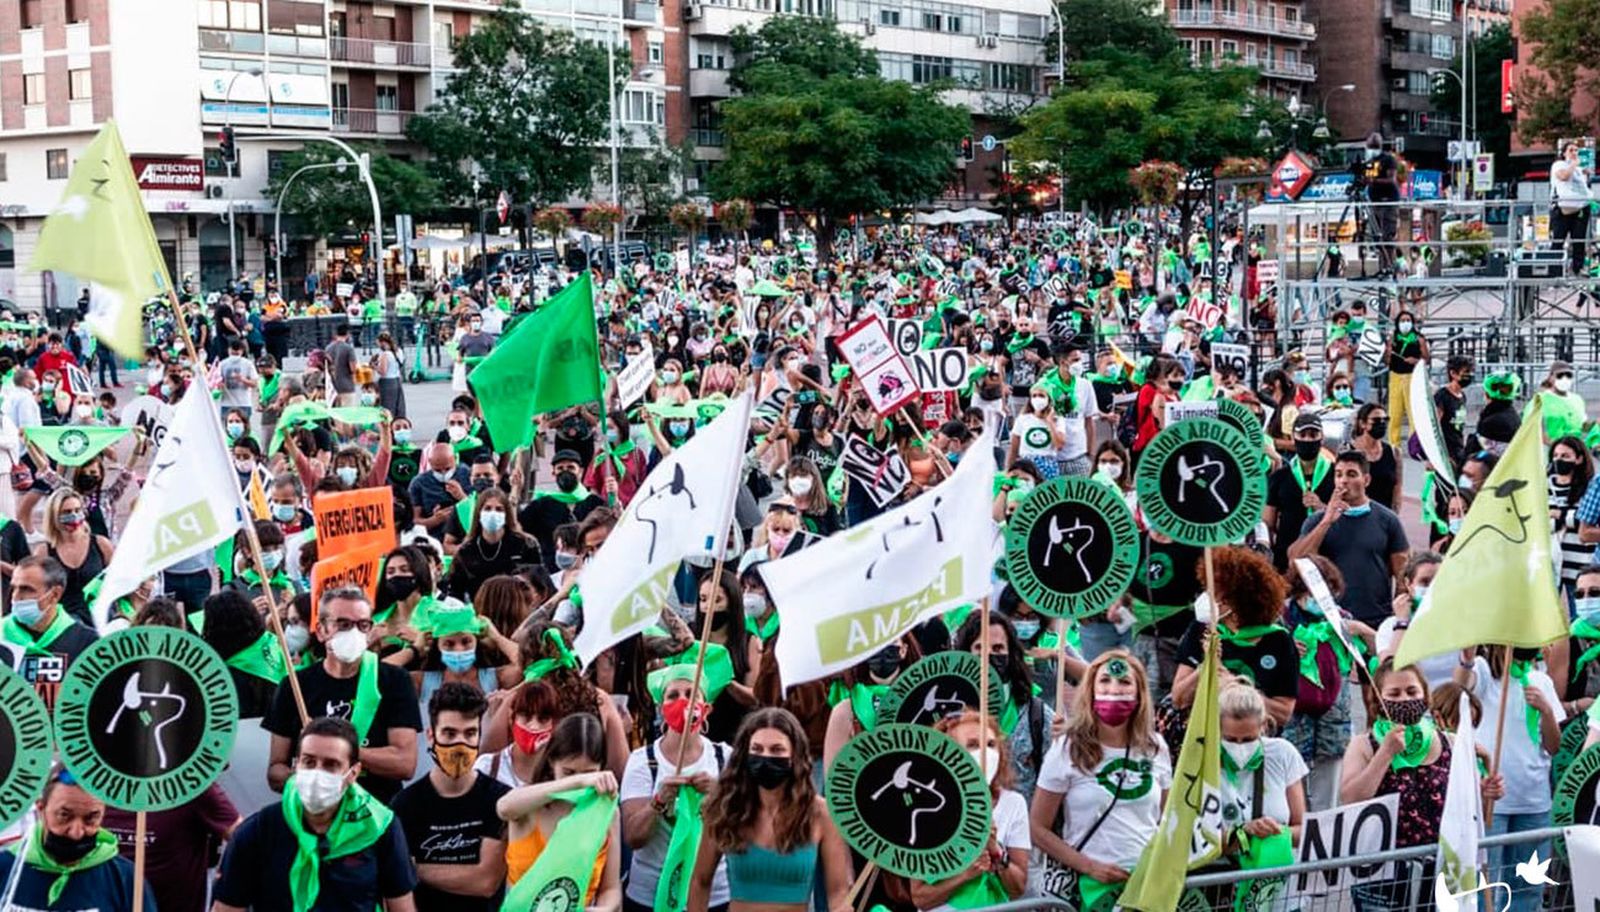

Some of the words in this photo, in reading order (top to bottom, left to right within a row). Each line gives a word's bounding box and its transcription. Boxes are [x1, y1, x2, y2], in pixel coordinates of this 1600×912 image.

[139, 163, 200, 185] Almirante
[151, 163, 200, 172] DETECTIVES
[1188, 297, 1220, 329] NO
[1359, 328, 1384, 363] NO
[913, 350, 966, 389] NO
[1213, 353, 1246, 381] NO
[318, 503, 387, 547] ¡VERGÜENZA!
[1297, 803, 1392, 891] NO
